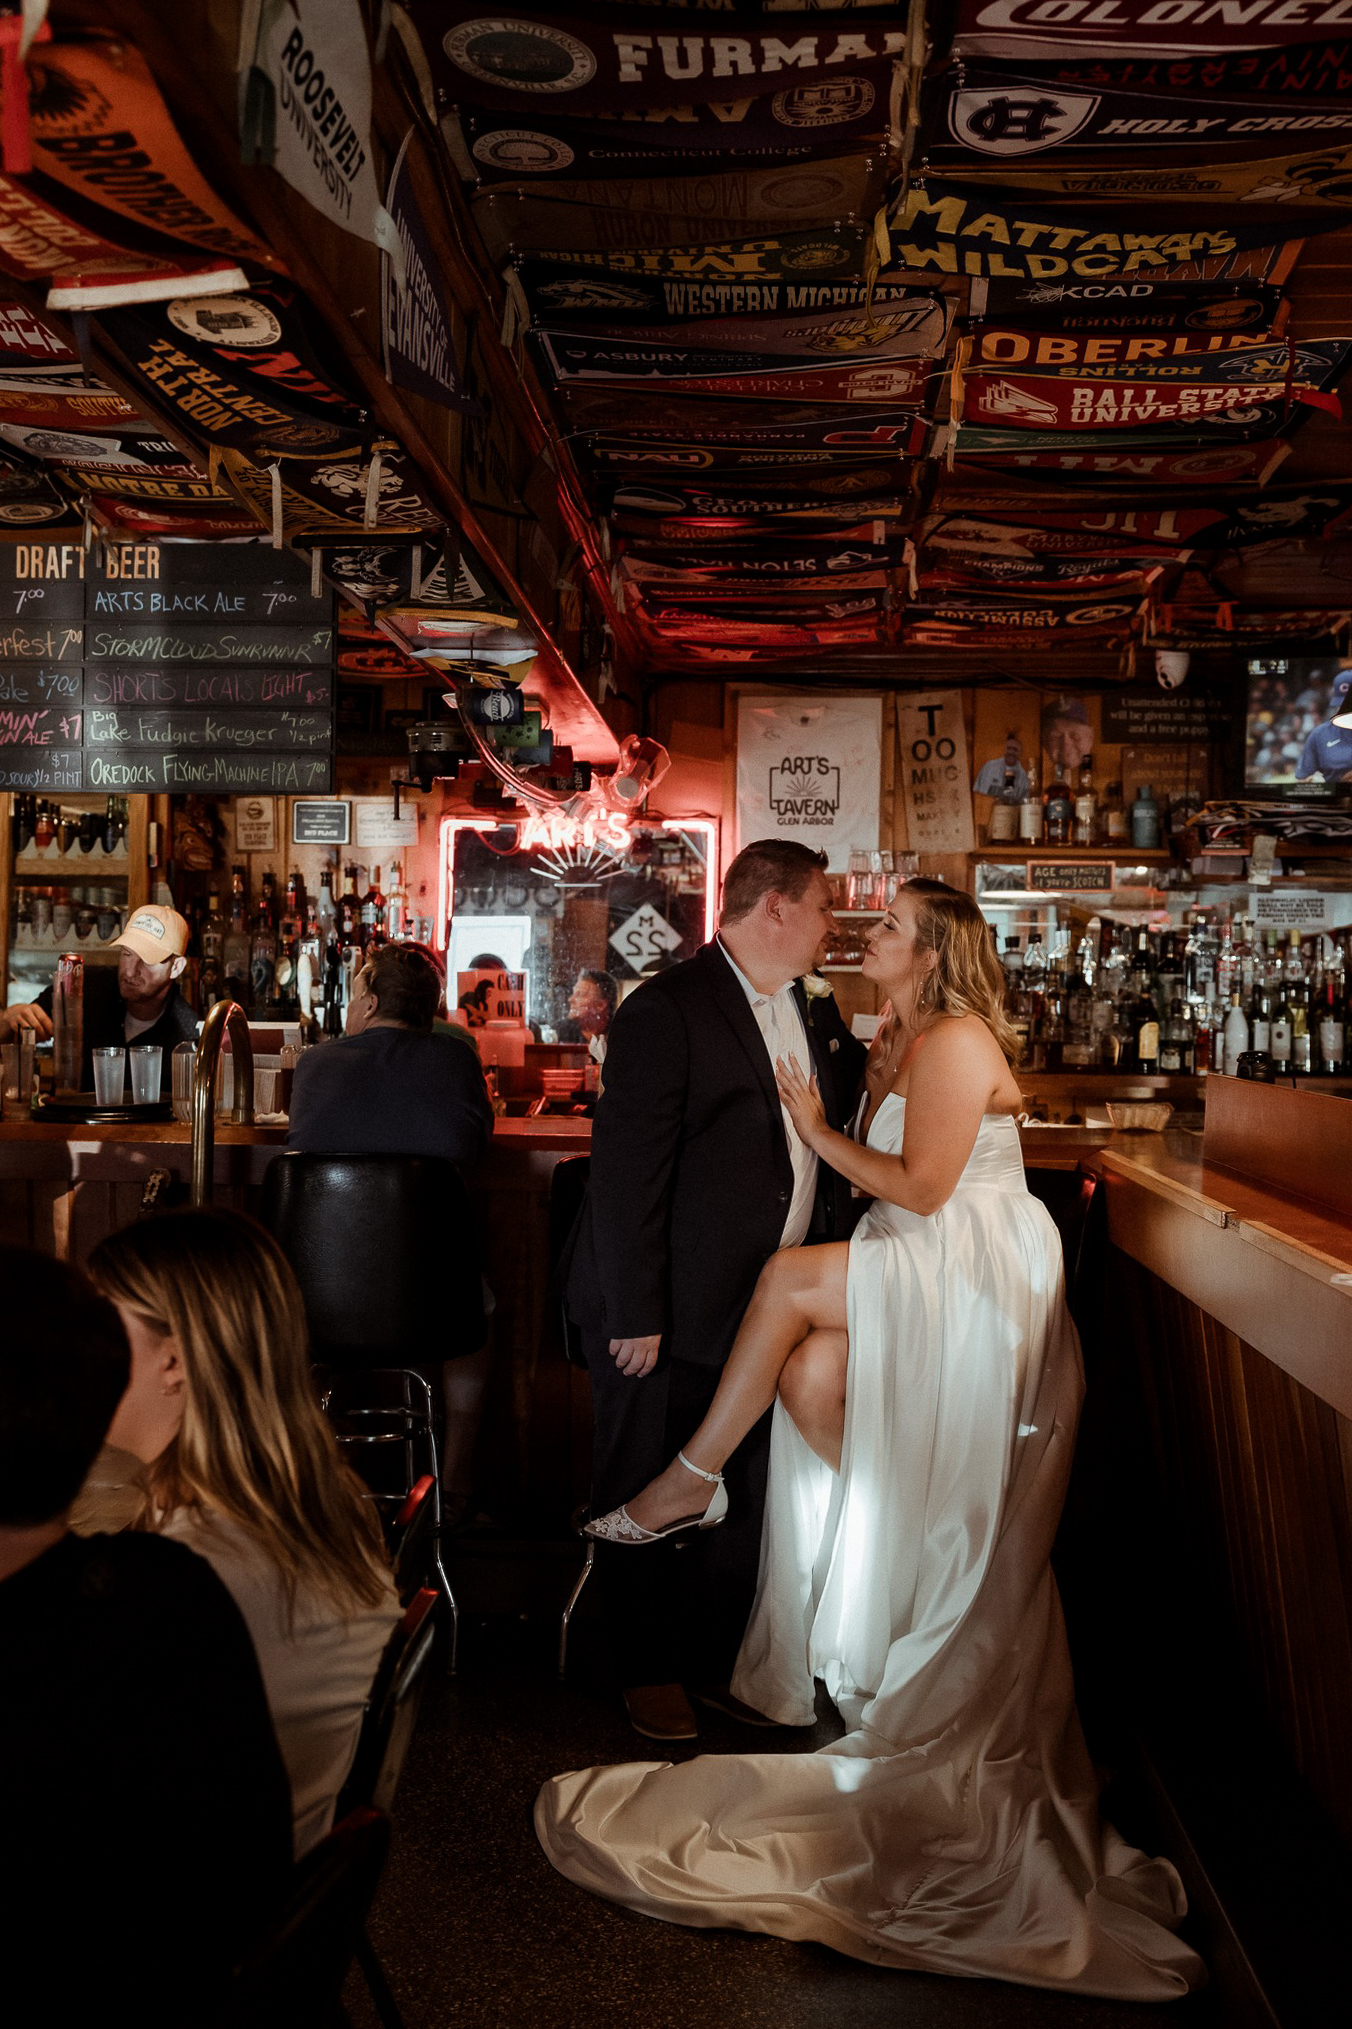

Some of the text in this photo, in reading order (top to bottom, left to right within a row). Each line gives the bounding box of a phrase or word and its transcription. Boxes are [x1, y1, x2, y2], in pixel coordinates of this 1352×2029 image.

[281, 27, 367, 182] ROOSEVELT
[1097, 117, 1224, 135] HOLY
[278, 64, 354, 220] UNIVERSITY
[588, 142, 813, 159] Connecticut College
[36, 131, 215, 229] BROTHER
[890, 188, 1221, 253] MATTAWAN
[898, 229, 1237, 279] WILDCATS
[663, 282, 907, 316] WESTERN MICHIGAN
[1060, 284, 1155, 299] KCAD
[592, 351, 689, 363] ASBURY
[980, 331, 1270, 366] OBERLIN
[149, 338, 294, 425] CENTRAL
[1057, 365, 1204, 378] ROLLINS
[137, 358, 243, 432] NORTH
[1071, 386, 1285, 409] BALL STATE
[1070, 392, 1284, 423] UNIVERSITY
[84, 473, 188, 498] NOTRE
[16, 546, 160, 579] DRAFT BEER
[742, 557, 818, 572] SETON
[963, 559, 1046, 573] CHAMPIONS
[94, 591, 145, 613] ARTS
[150, 593, 209, 613] BLACK
[214, 591, 246, 613] ALE
[0, 674, 29, 703] ale
[91, 711, 119, 729] Big
[21, 729, 55, 746] ALE
[205, 716, 278, 747] Krueger
[780, 755, 831, 775] ART'S
[54, 770, 83, 787] PINT
[773, 798, 836, 816] TAVERN
[777, 816, 835, 826] GLEN ARBOR
[1034, 867, 1057, 877] AGE
[496, 1000, 525, 1019] ONLY
